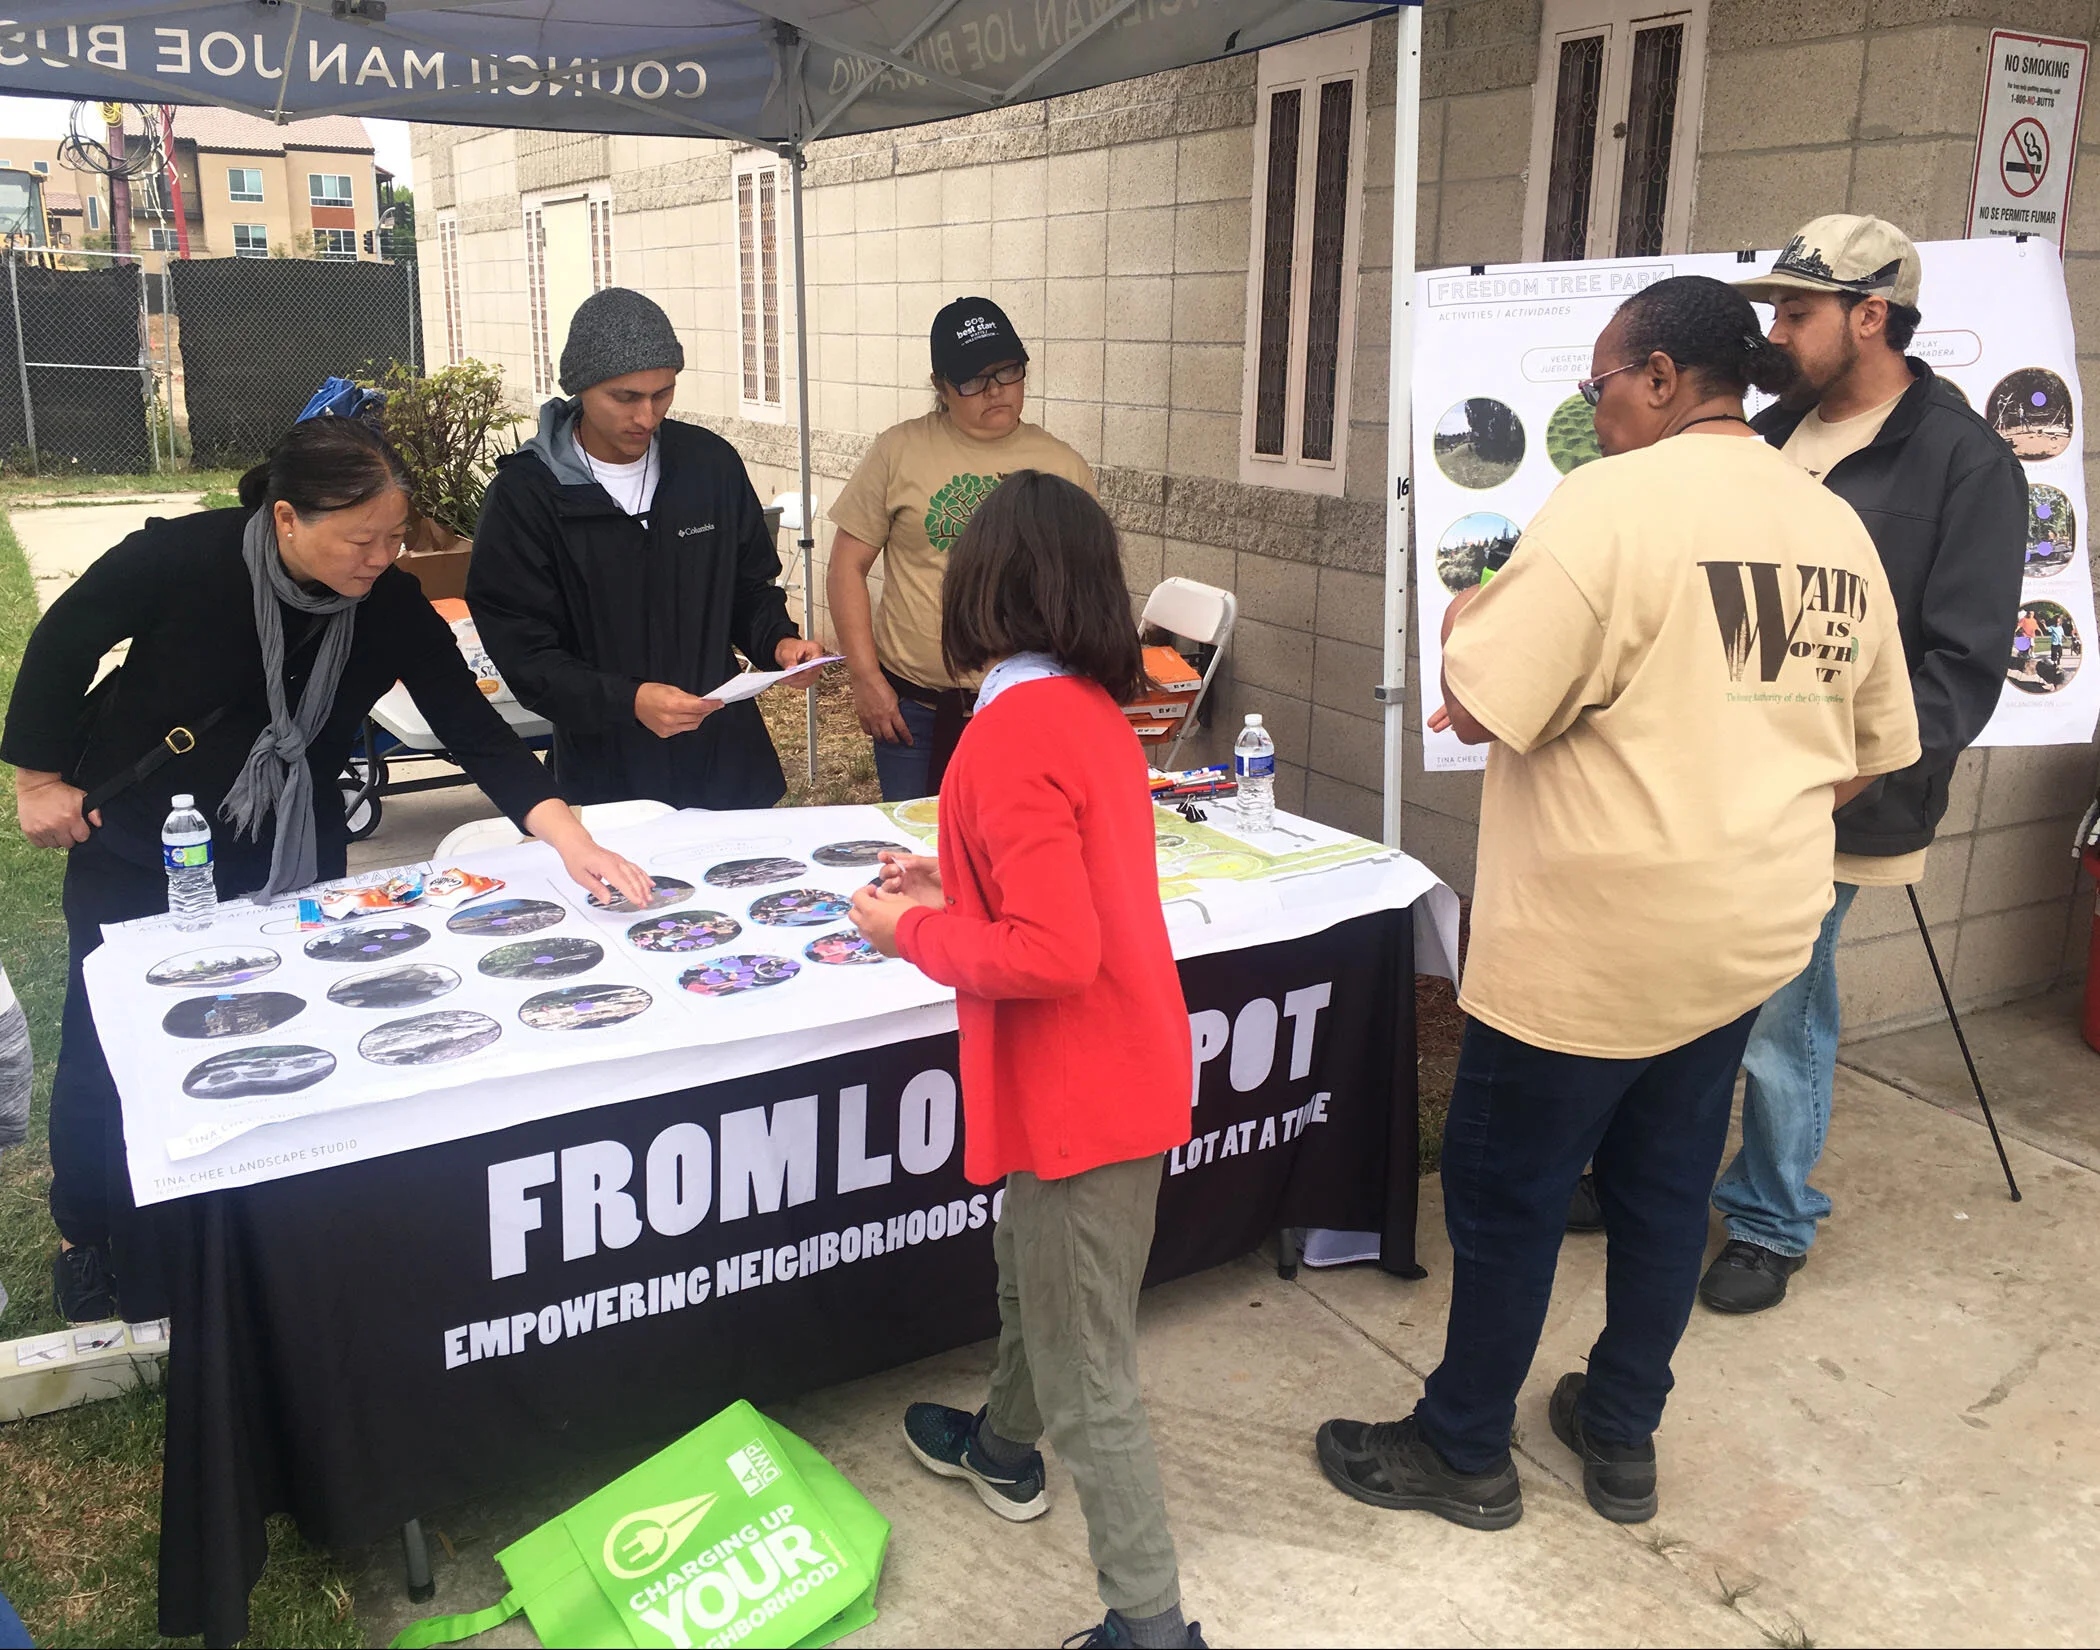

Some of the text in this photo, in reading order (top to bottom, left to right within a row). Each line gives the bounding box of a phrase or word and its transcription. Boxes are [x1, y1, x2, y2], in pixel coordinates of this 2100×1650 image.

[2004, 54, 2070, 79] NO SMOKING
[1979, 206, 2057, 225] NO SE PERMITE FUMAR
[1437, 271, 1665, 301] FREEDOM TREE PARK
[1439, 310, 1493, 321] ACTIVITIES
[1504, 306, 1571, 318] ACTIVIDADES
[956, 325, 976, 339] best
[976, 321, 997, 331] start
[1916, 340, 1938, 348] PLAY
[1919, 349, 1955, 357] MADERA
[1551, 354, 1593, 363] VEGETATI
[1397, 477, 1410, 500] 16
[684, 523, 716, 536] Columbia
[1825, 620, 1851, 638] IS
[153, 1138, 358, 1189] TINA CHEE LANDSCAPE STUDIO
[487, 1093, 819, 1281] FROM
[443, 1264, 712, 1371] EMPOWERING
[715, 1191, 988, 1299] NEIGHBORHOODS
[1169, 1129, 1221, 1177] LOT
[1219, 1119, 1257, 1159] AT
[1257, 1115, 1277, 1151] A
[628, 1528, 761, 1612] CHARGING
[760, 1503, 796, 1533] UP
[638, 1524, 829, 1649] YOUR
